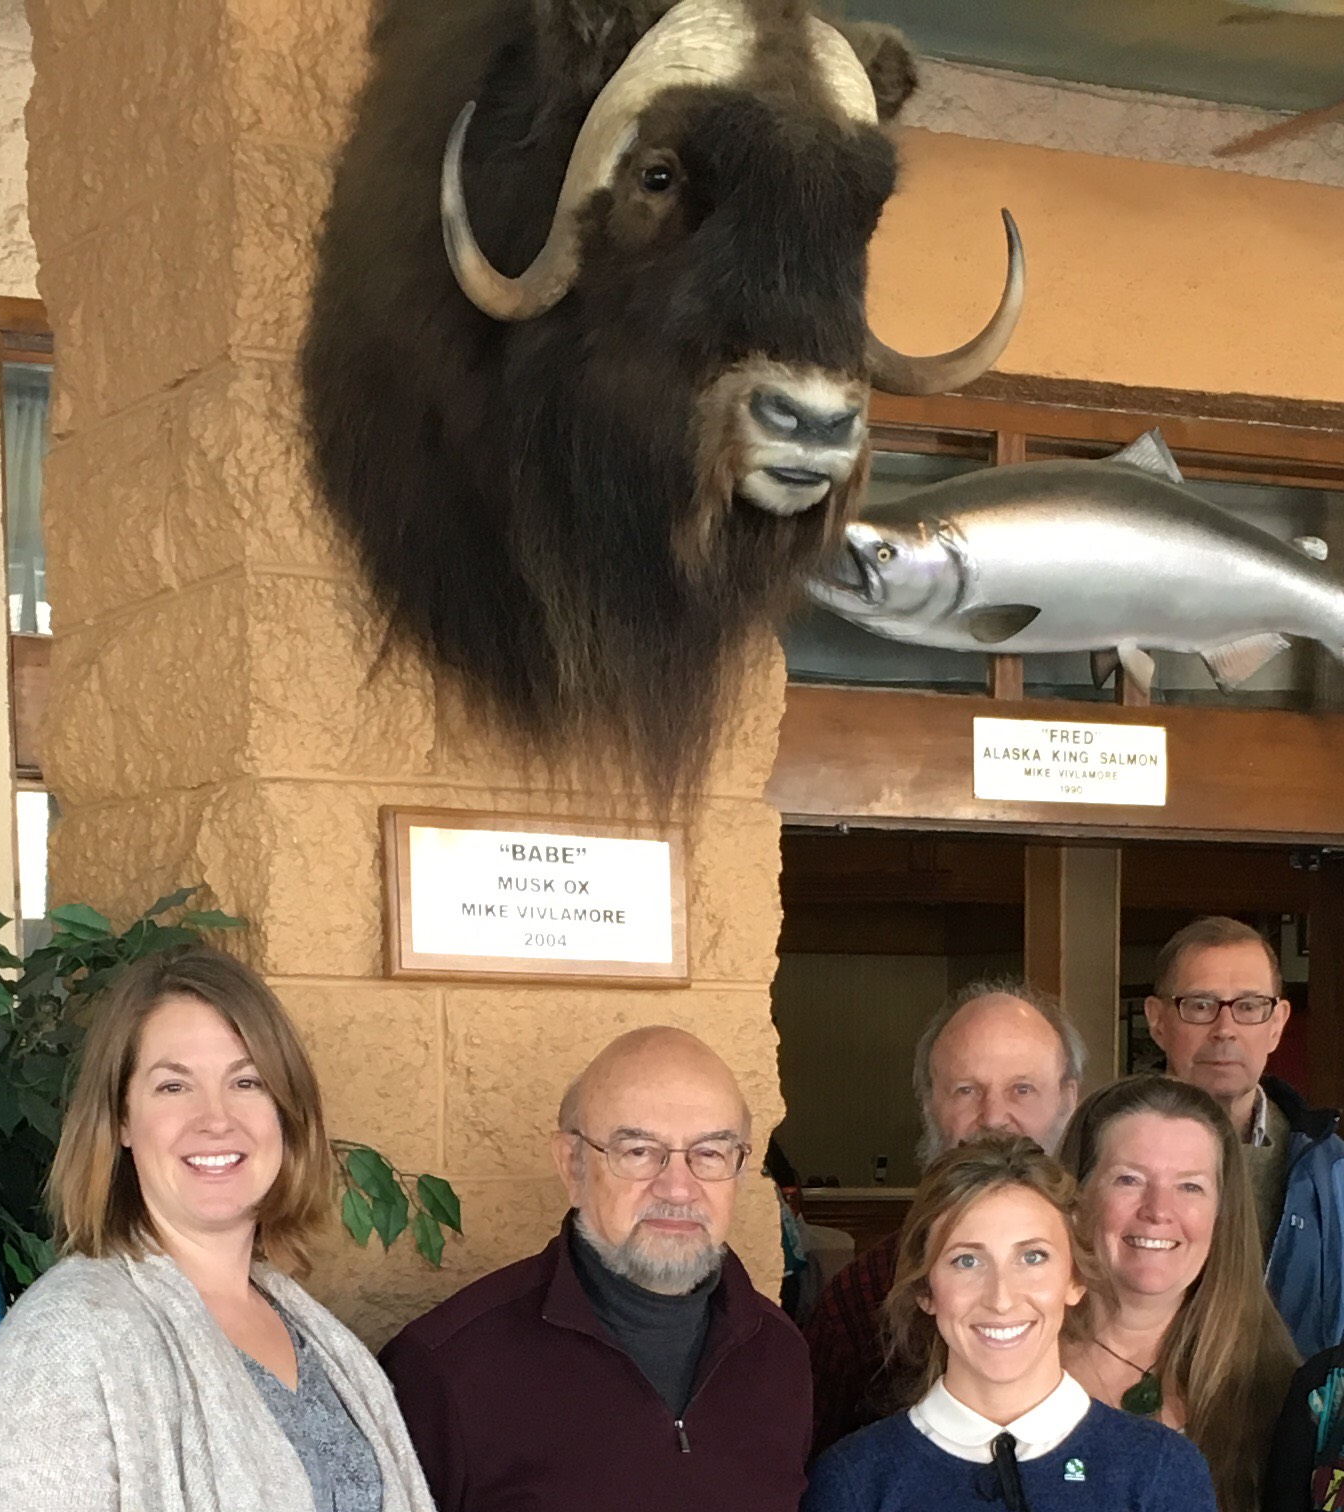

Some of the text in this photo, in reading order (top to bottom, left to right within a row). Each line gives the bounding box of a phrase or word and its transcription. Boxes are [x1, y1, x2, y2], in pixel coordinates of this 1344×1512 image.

[982, 746, 1159, 767] ALASKA KING SALMON
[1023, 767, 1118, 781] MIKE VIVLAMORE
[497, 875, 590, 896] MUSK OX
[461, 902, 626, 925] MIKE VIVLAMORE
[524, 932, 567, 948] 2004
